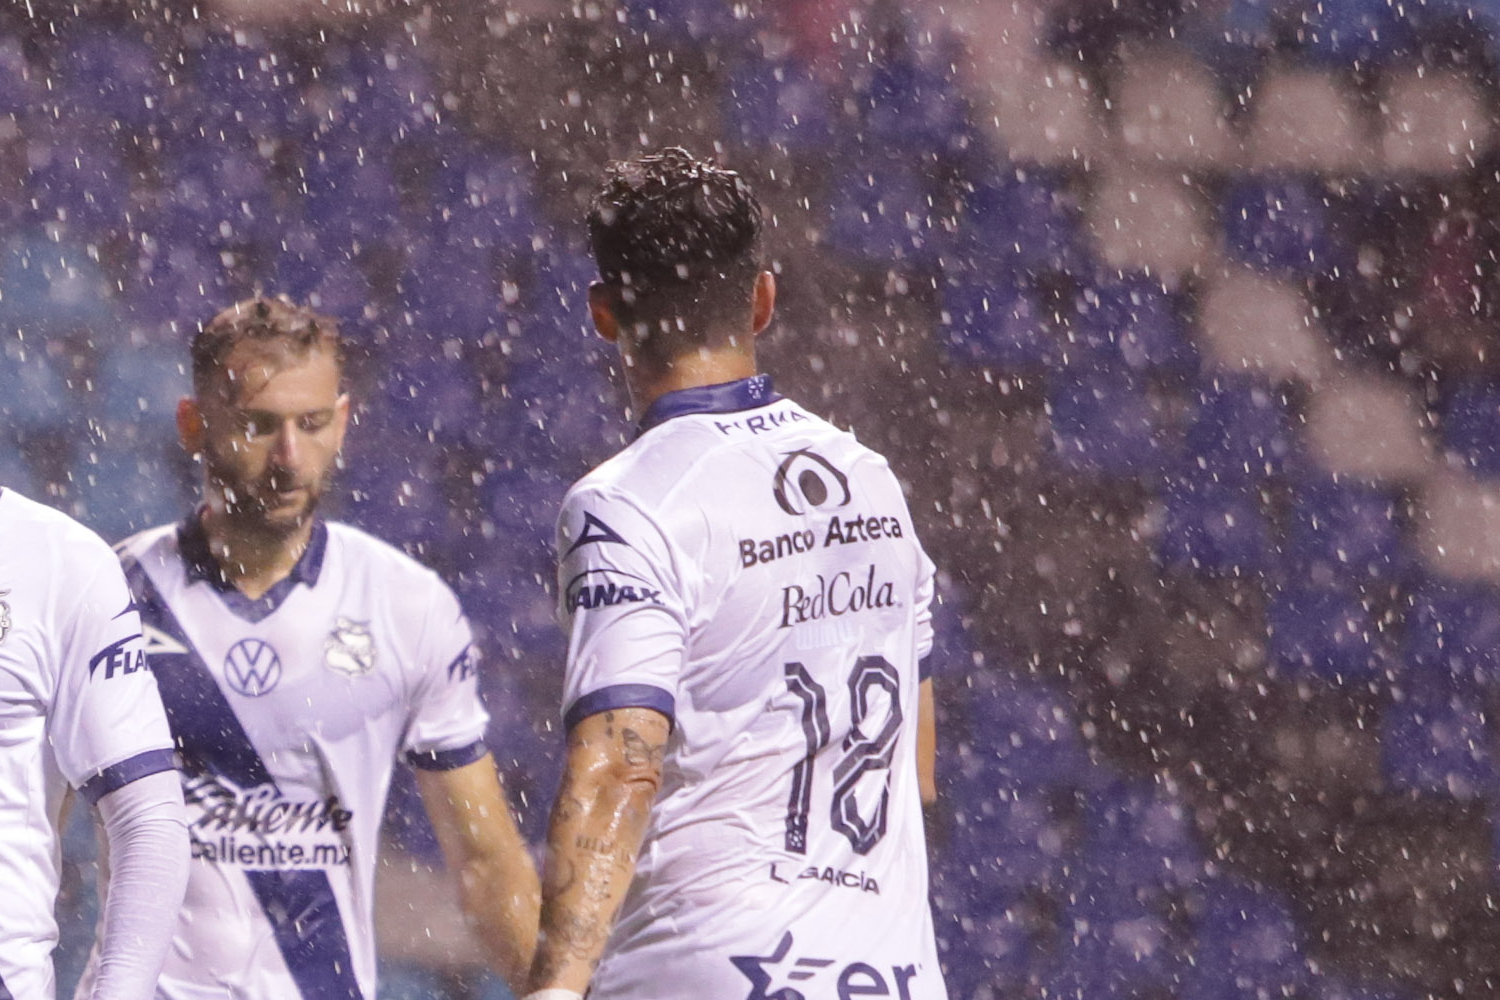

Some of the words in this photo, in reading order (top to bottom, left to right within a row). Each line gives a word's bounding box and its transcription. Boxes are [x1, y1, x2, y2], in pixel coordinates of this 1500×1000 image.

[739, 529, 815, 569] Banco
[823, 513, 903, 548] Azteca
[784, 655, 903, 856] 18
